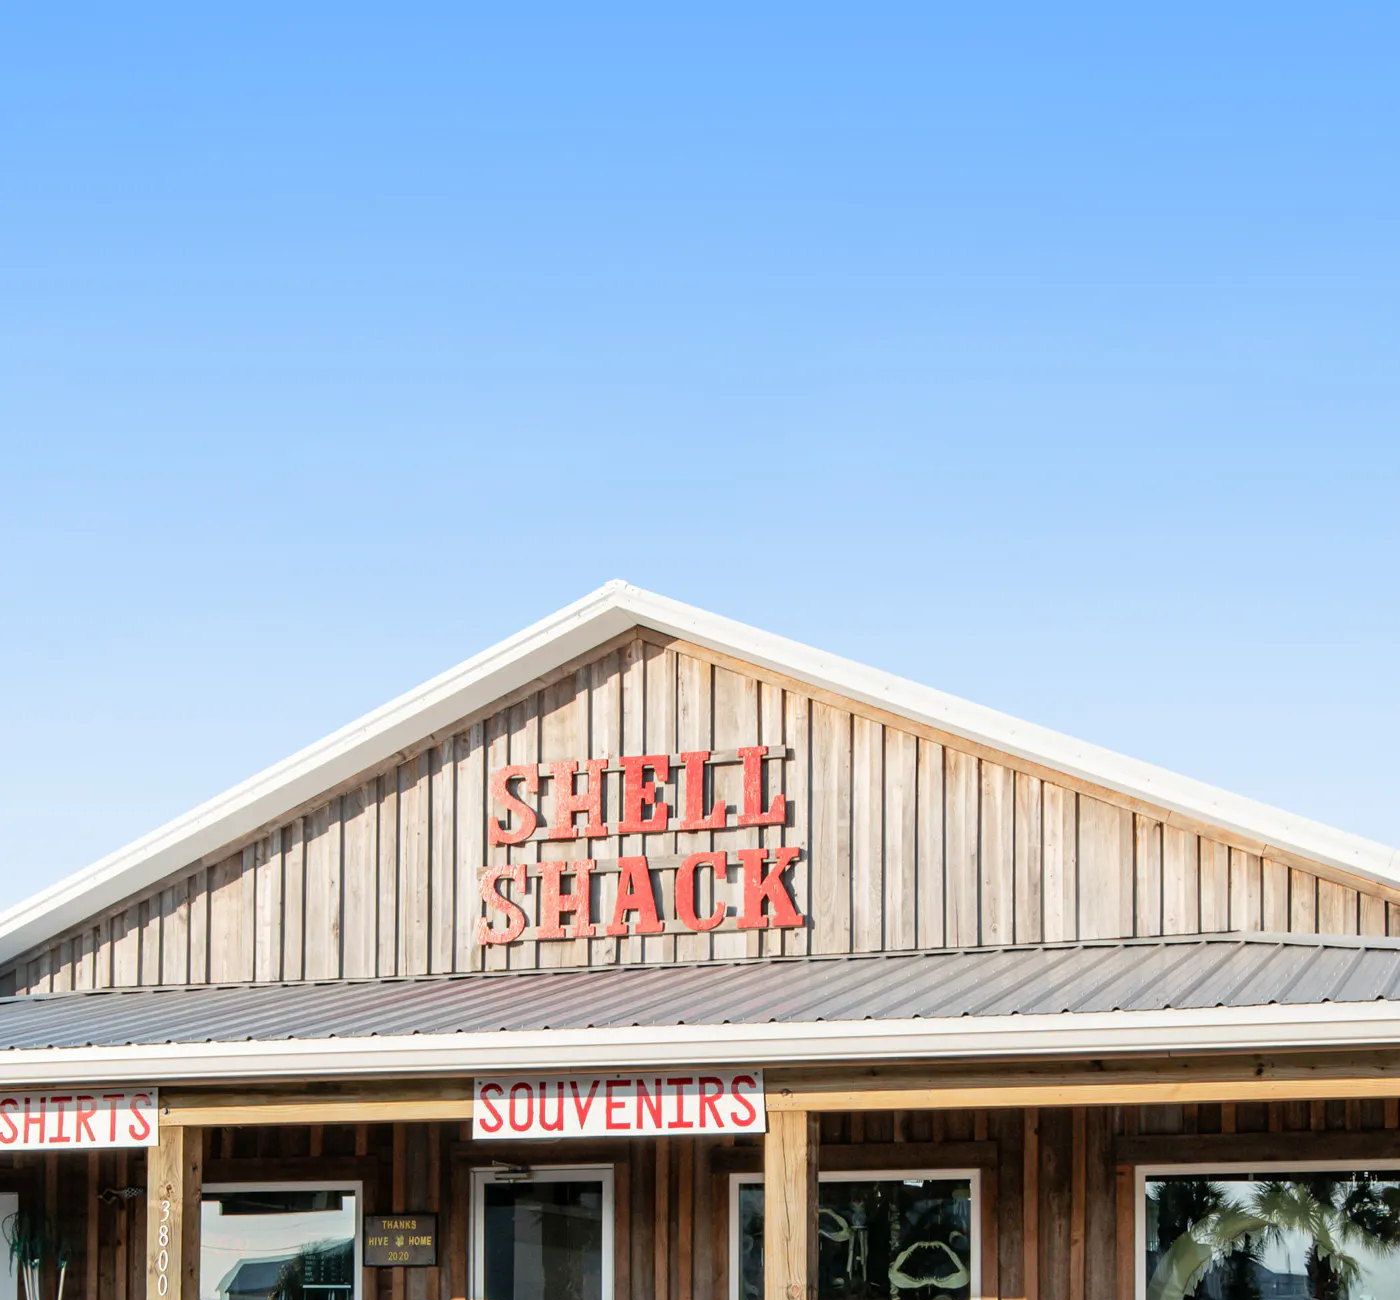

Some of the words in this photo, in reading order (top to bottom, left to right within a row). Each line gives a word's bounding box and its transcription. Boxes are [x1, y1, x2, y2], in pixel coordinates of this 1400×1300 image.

[489, 746, 785, 845] SHELL
[477, 847, 804, 945] SHACK
[0, 1093, 152, 1144] SHIRTS
[479, 1075, 757, 1132] SOUVENIRS
[158, 1200, 170, 1296] 3800
[368, 1236, 389, 1246] HIVE
[408, 1236, 432, 1246] HOME
[382, 1220, 417, 1230] THANKS
[388, 1251, 409, 1261] 2020
